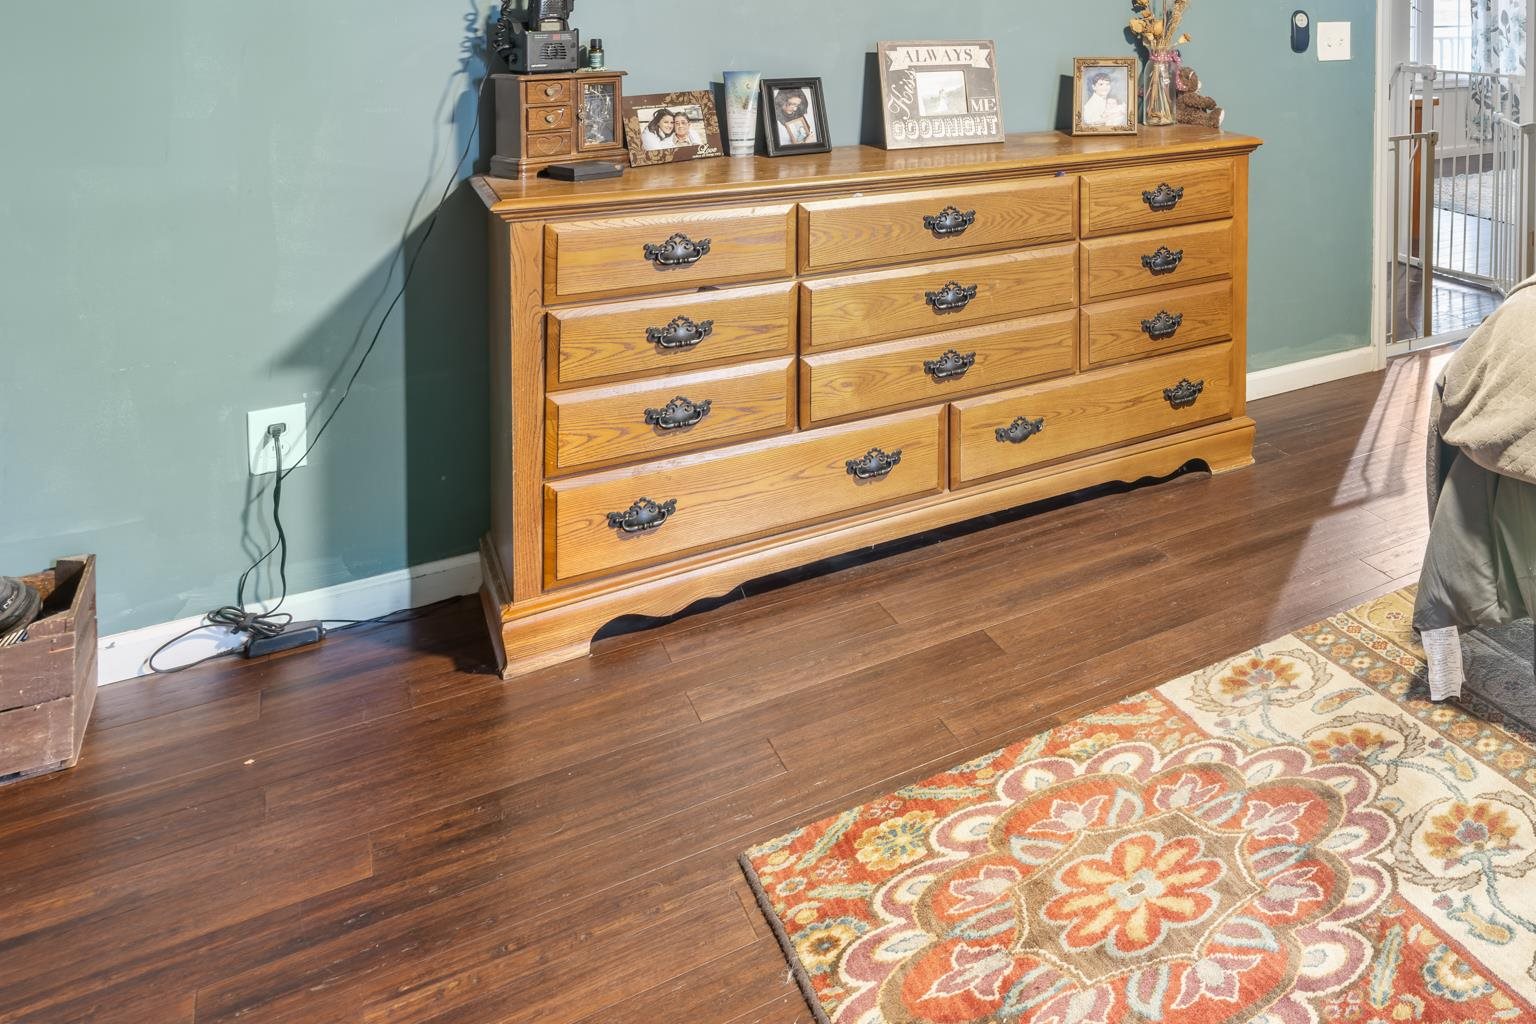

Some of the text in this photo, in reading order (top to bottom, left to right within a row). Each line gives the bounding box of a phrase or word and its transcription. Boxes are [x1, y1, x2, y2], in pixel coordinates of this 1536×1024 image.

[904, 49, 973, 63] ALWAYS
[888, 67, 916, 121] Kiss
[970, 98, 997, 113] ME
[893, 115, 998, 140] GOODNIGHT
